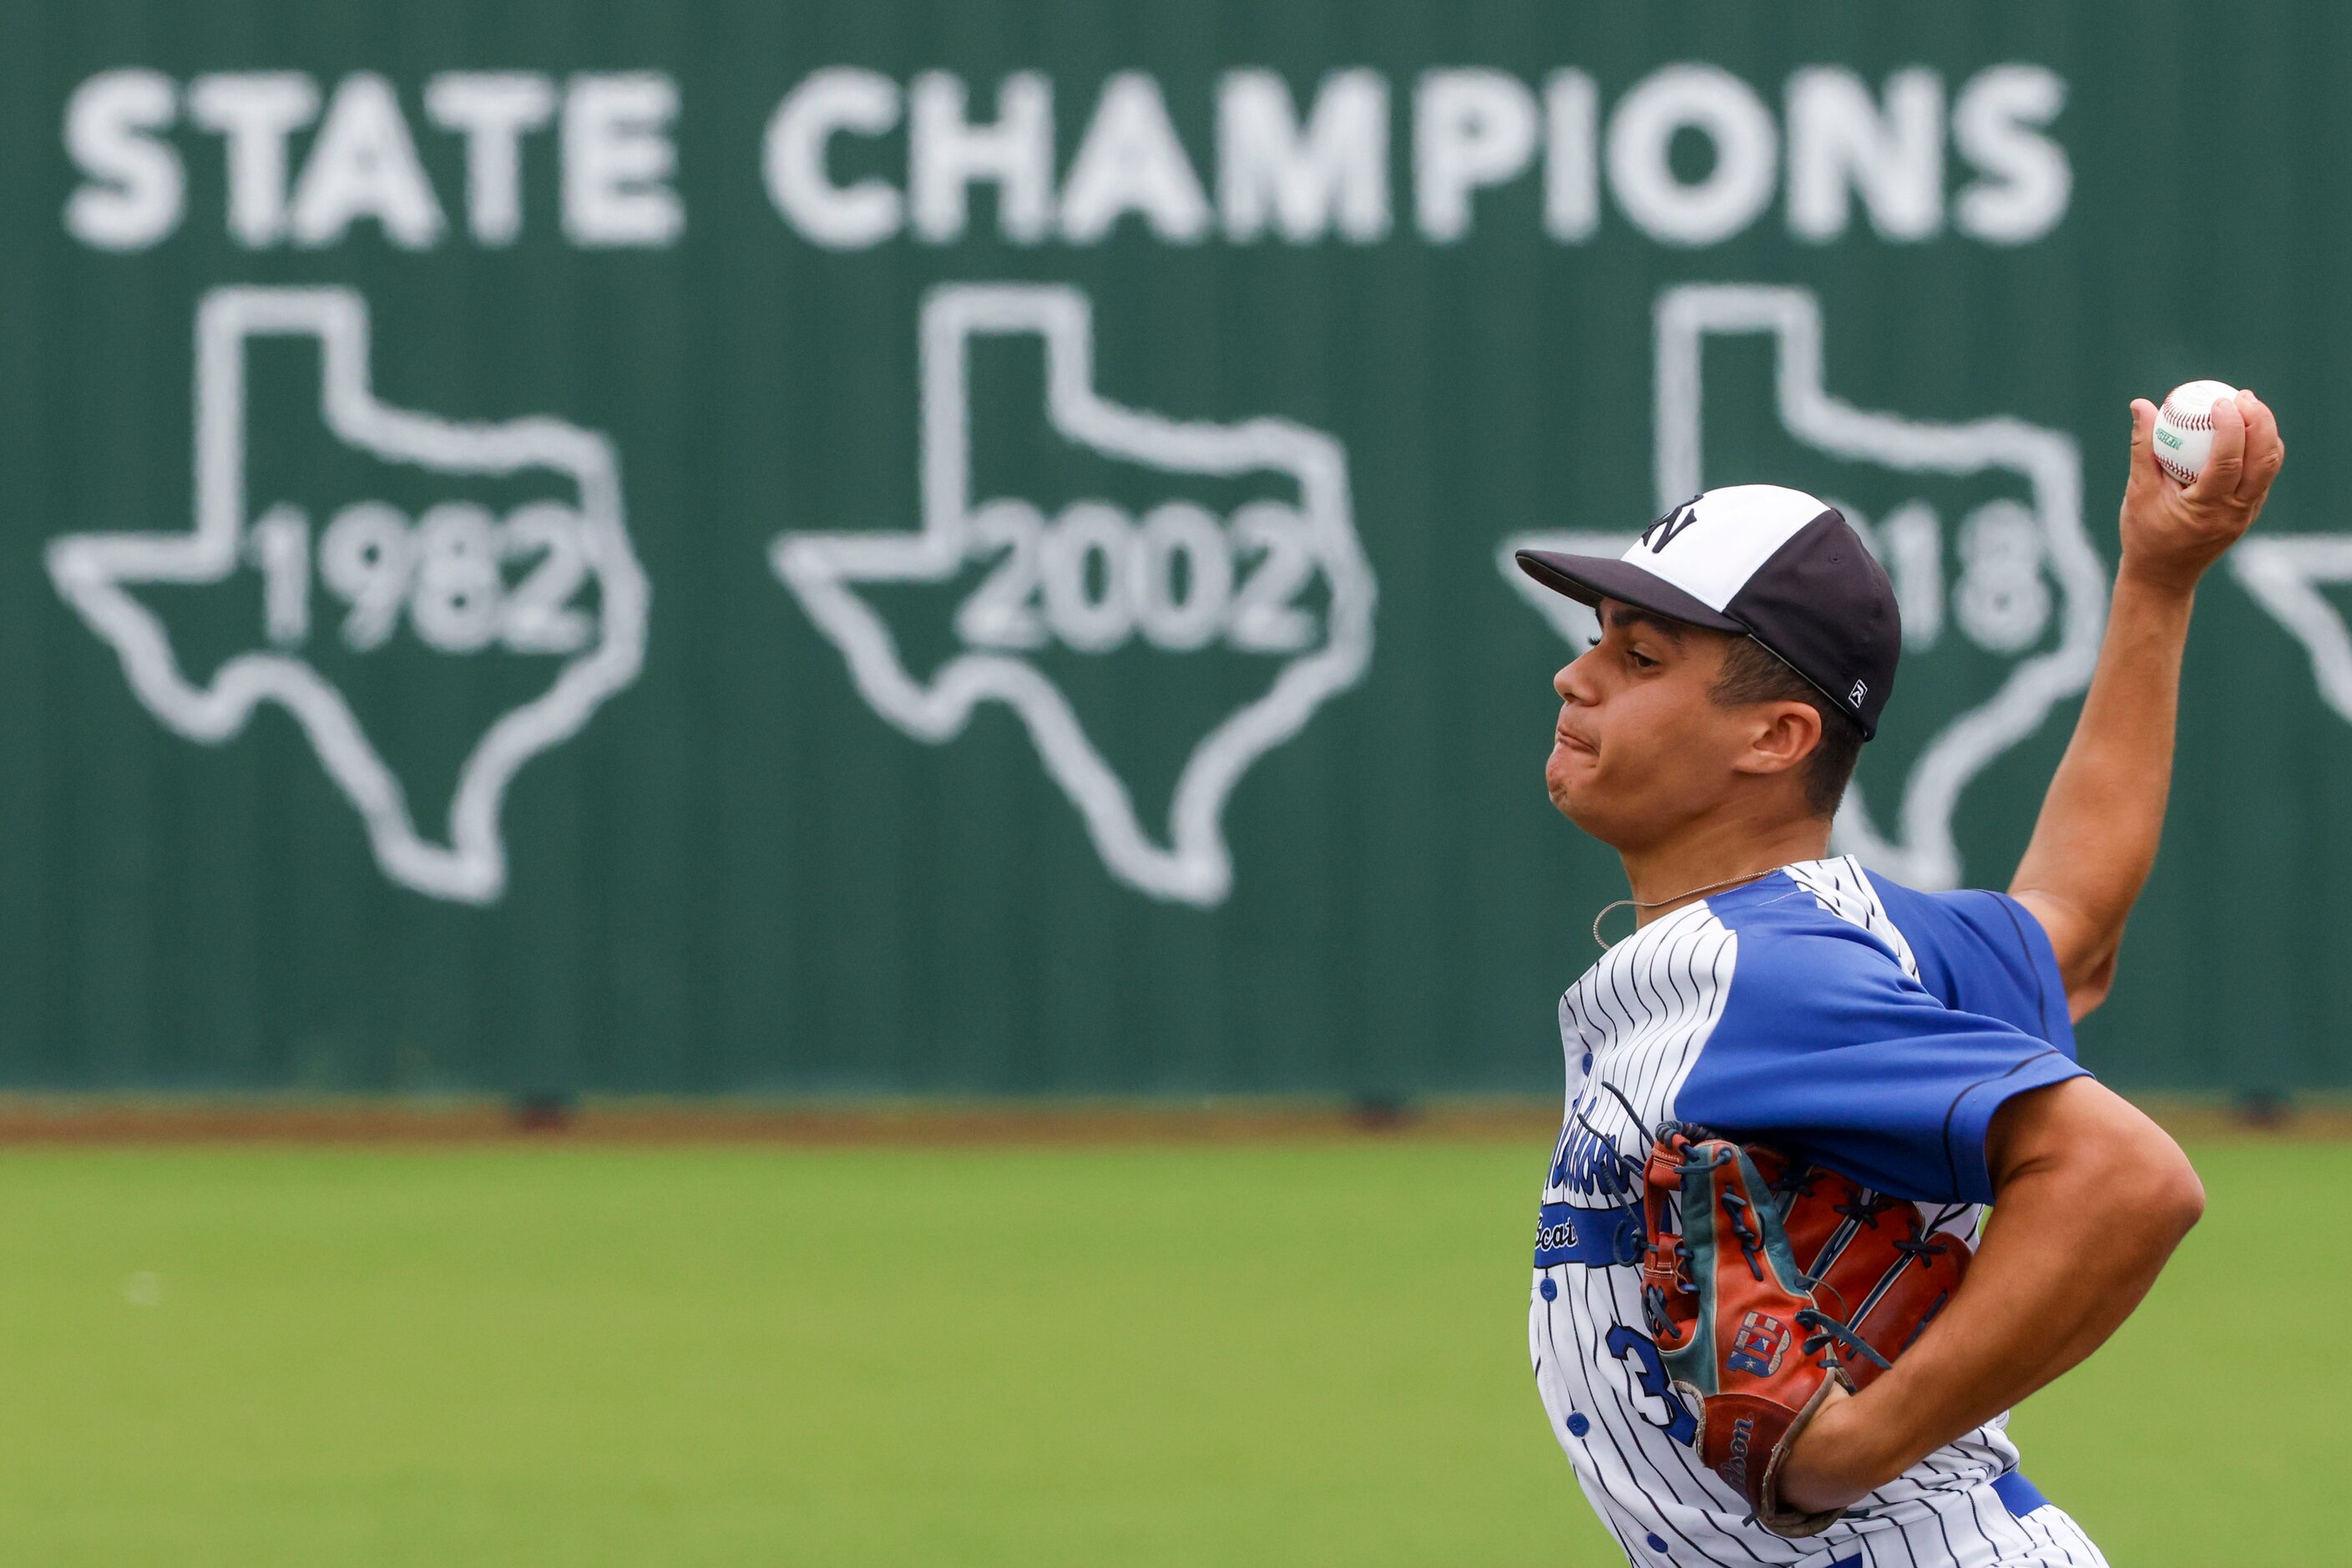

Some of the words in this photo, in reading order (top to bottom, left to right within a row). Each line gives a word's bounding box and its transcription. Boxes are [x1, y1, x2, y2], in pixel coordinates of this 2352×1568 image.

[67, 70, 683, 247] STATE
[764, 65, 2071, 245] CHAMPIONS
[248, 501, 598, 651] 1982
[955, 499, 1316, 651] 2002
[1828, 498, 2052, 654] 18
